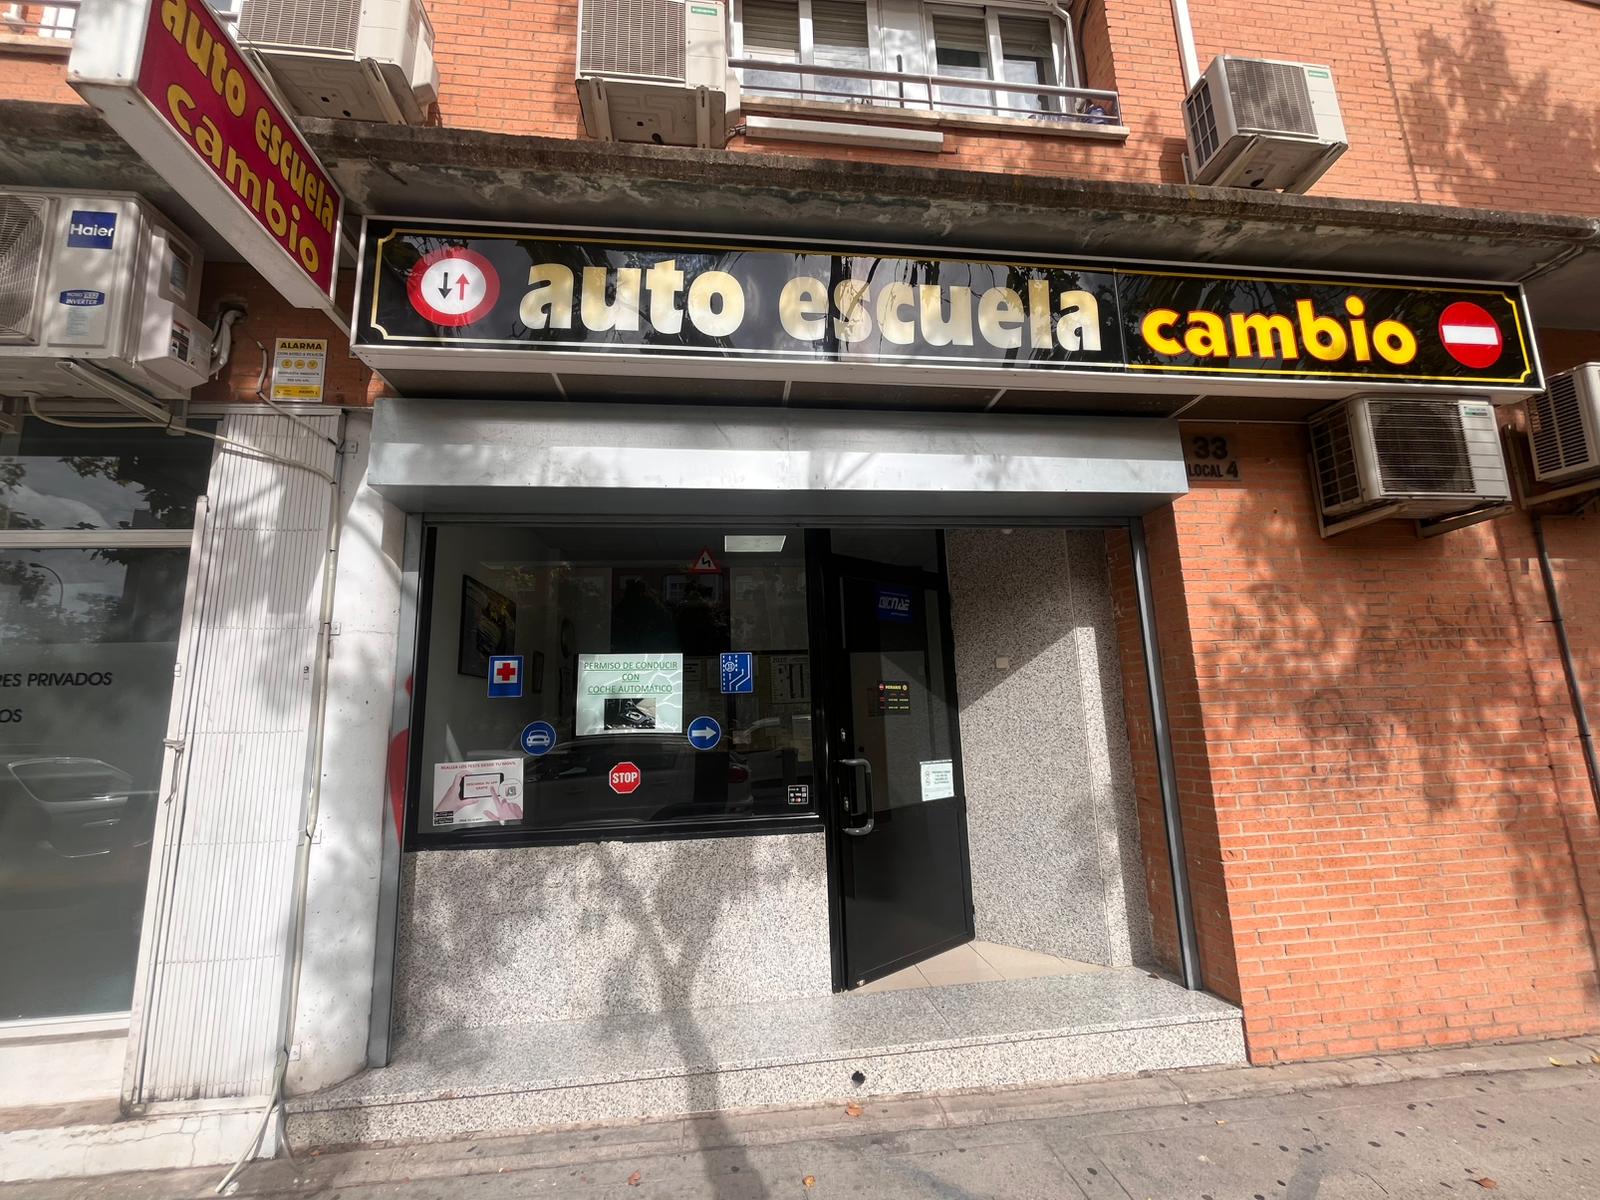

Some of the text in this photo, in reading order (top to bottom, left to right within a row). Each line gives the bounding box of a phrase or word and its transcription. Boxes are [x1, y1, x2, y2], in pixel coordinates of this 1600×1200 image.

[161, 0, 334, 233] auto escuela
[167, 83, 319, 273] cambio
[70, 224, 114, 237] Haier
[519, 259, 1418, 365] auto escuela cambio
[280, 342, 322, 350] ALARMA
[1193, 436, 1228, 459] 33
[1188, 461, 1239, 478] LOCAL 4
[584, 662, 620, 670] PERMISO
[635, 661, 678, 669] CONDUCIR
[0, 672, 113, 688] ES PRIVADOS
[622, 673, 640, 681] CON
[587, 683, 673, 694] COCHE AUTOMÁTICO
[612, 772, 638, 784] STOP
